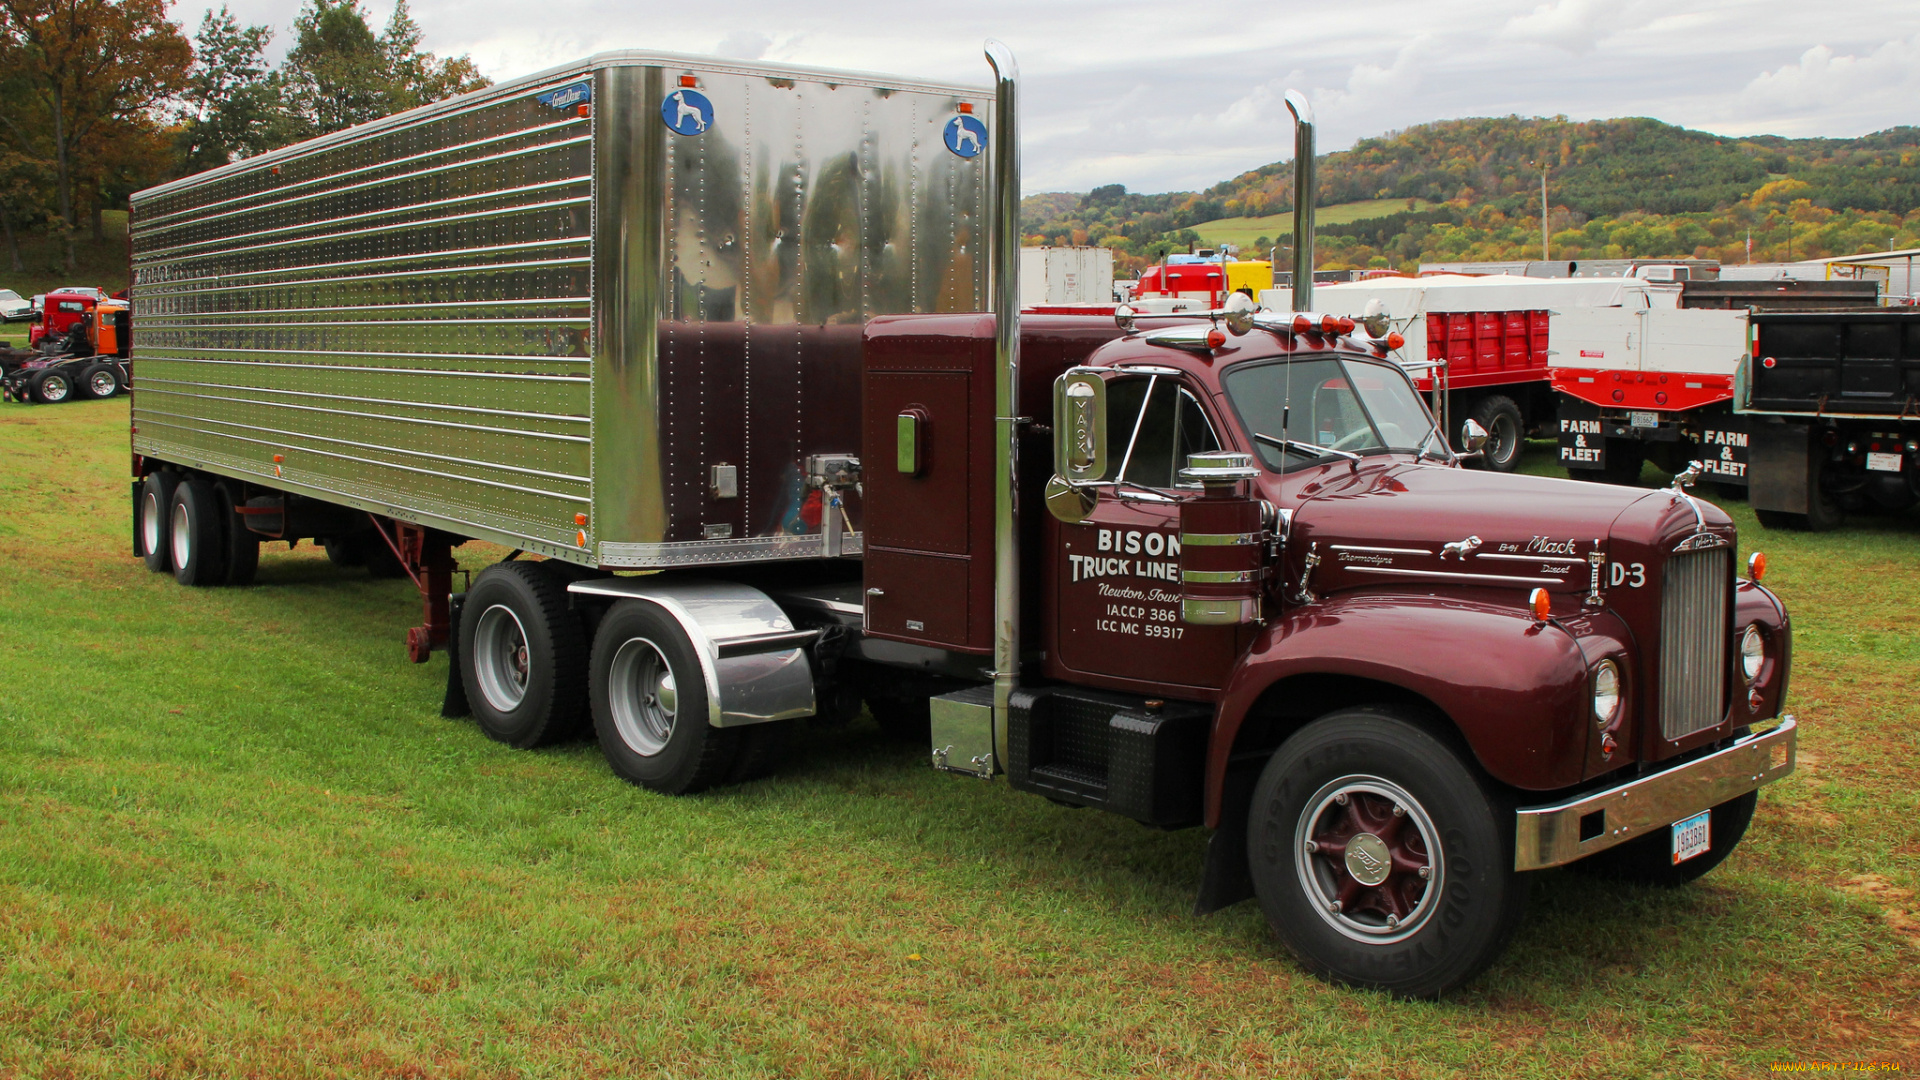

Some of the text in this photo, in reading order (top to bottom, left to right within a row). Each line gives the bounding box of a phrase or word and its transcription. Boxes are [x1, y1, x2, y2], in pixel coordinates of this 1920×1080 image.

[1561, 419, 1601, 434] FARM
[1575, 433, 1587, 447] &
[1704, 430, 1748, 447] FARM
[1561, 446, 1602, 462] FLEET
[1720, 446, 1734, 460] &
[1703, 458, 1747, 476] FLEET
[1098, 529, 1181, 556] BISON
[1524, 535, 1576, 555] Mack
[1338, 552, 1393, 566] Thermodyne
[1069, 554, 1181, 585] TRUCK LINE
[1540, 564, 1571, 574] Diesel
[1611, 562, 1646, 588] D-3
[1098, 582, 1147, 602] Newton,
[1149, 608, 1177, 622] 386
[1120, 622, 1140, 635] MC
[1144, 624, 1184, 640] 59317
